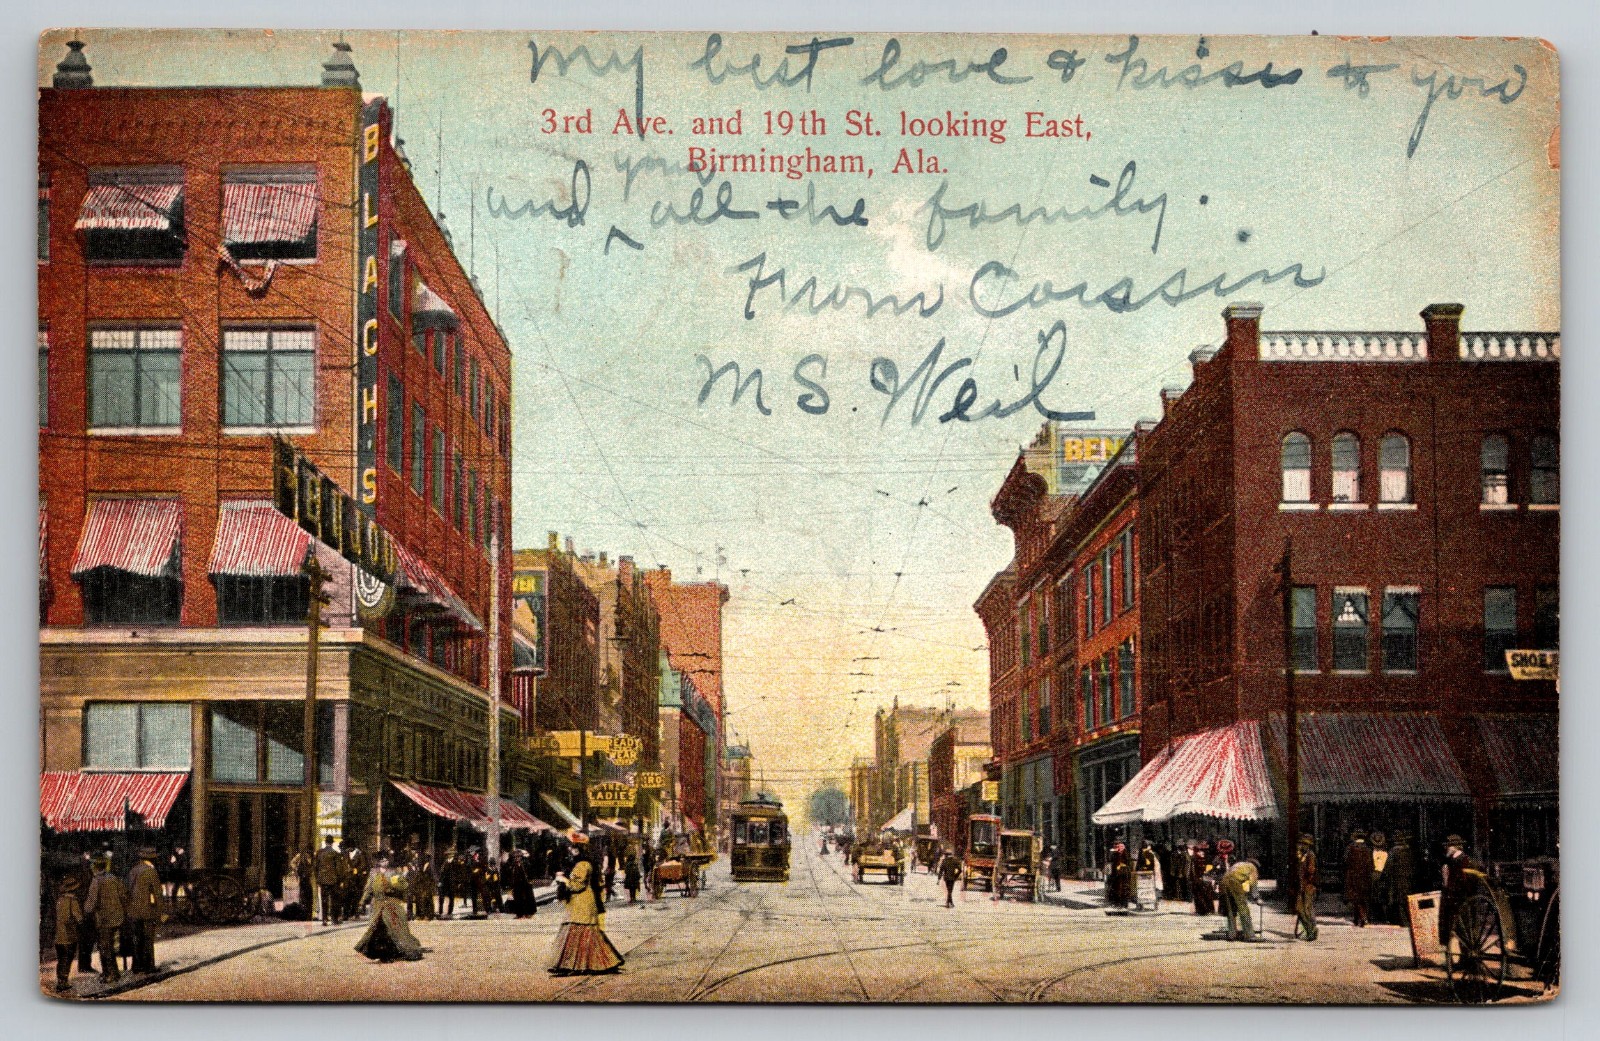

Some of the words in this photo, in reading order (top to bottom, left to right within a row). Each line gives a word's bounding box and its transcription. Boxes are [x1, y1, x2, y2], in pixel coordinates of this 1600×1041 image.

[689, 33, 855, 94] best
[859, 37, 1035, 93] love
[486, 160, 593, 229] and
[649, 180, 761, 230] all
[766, 179, 870, 227] the
[588, 790, 637, 801] LADIES
